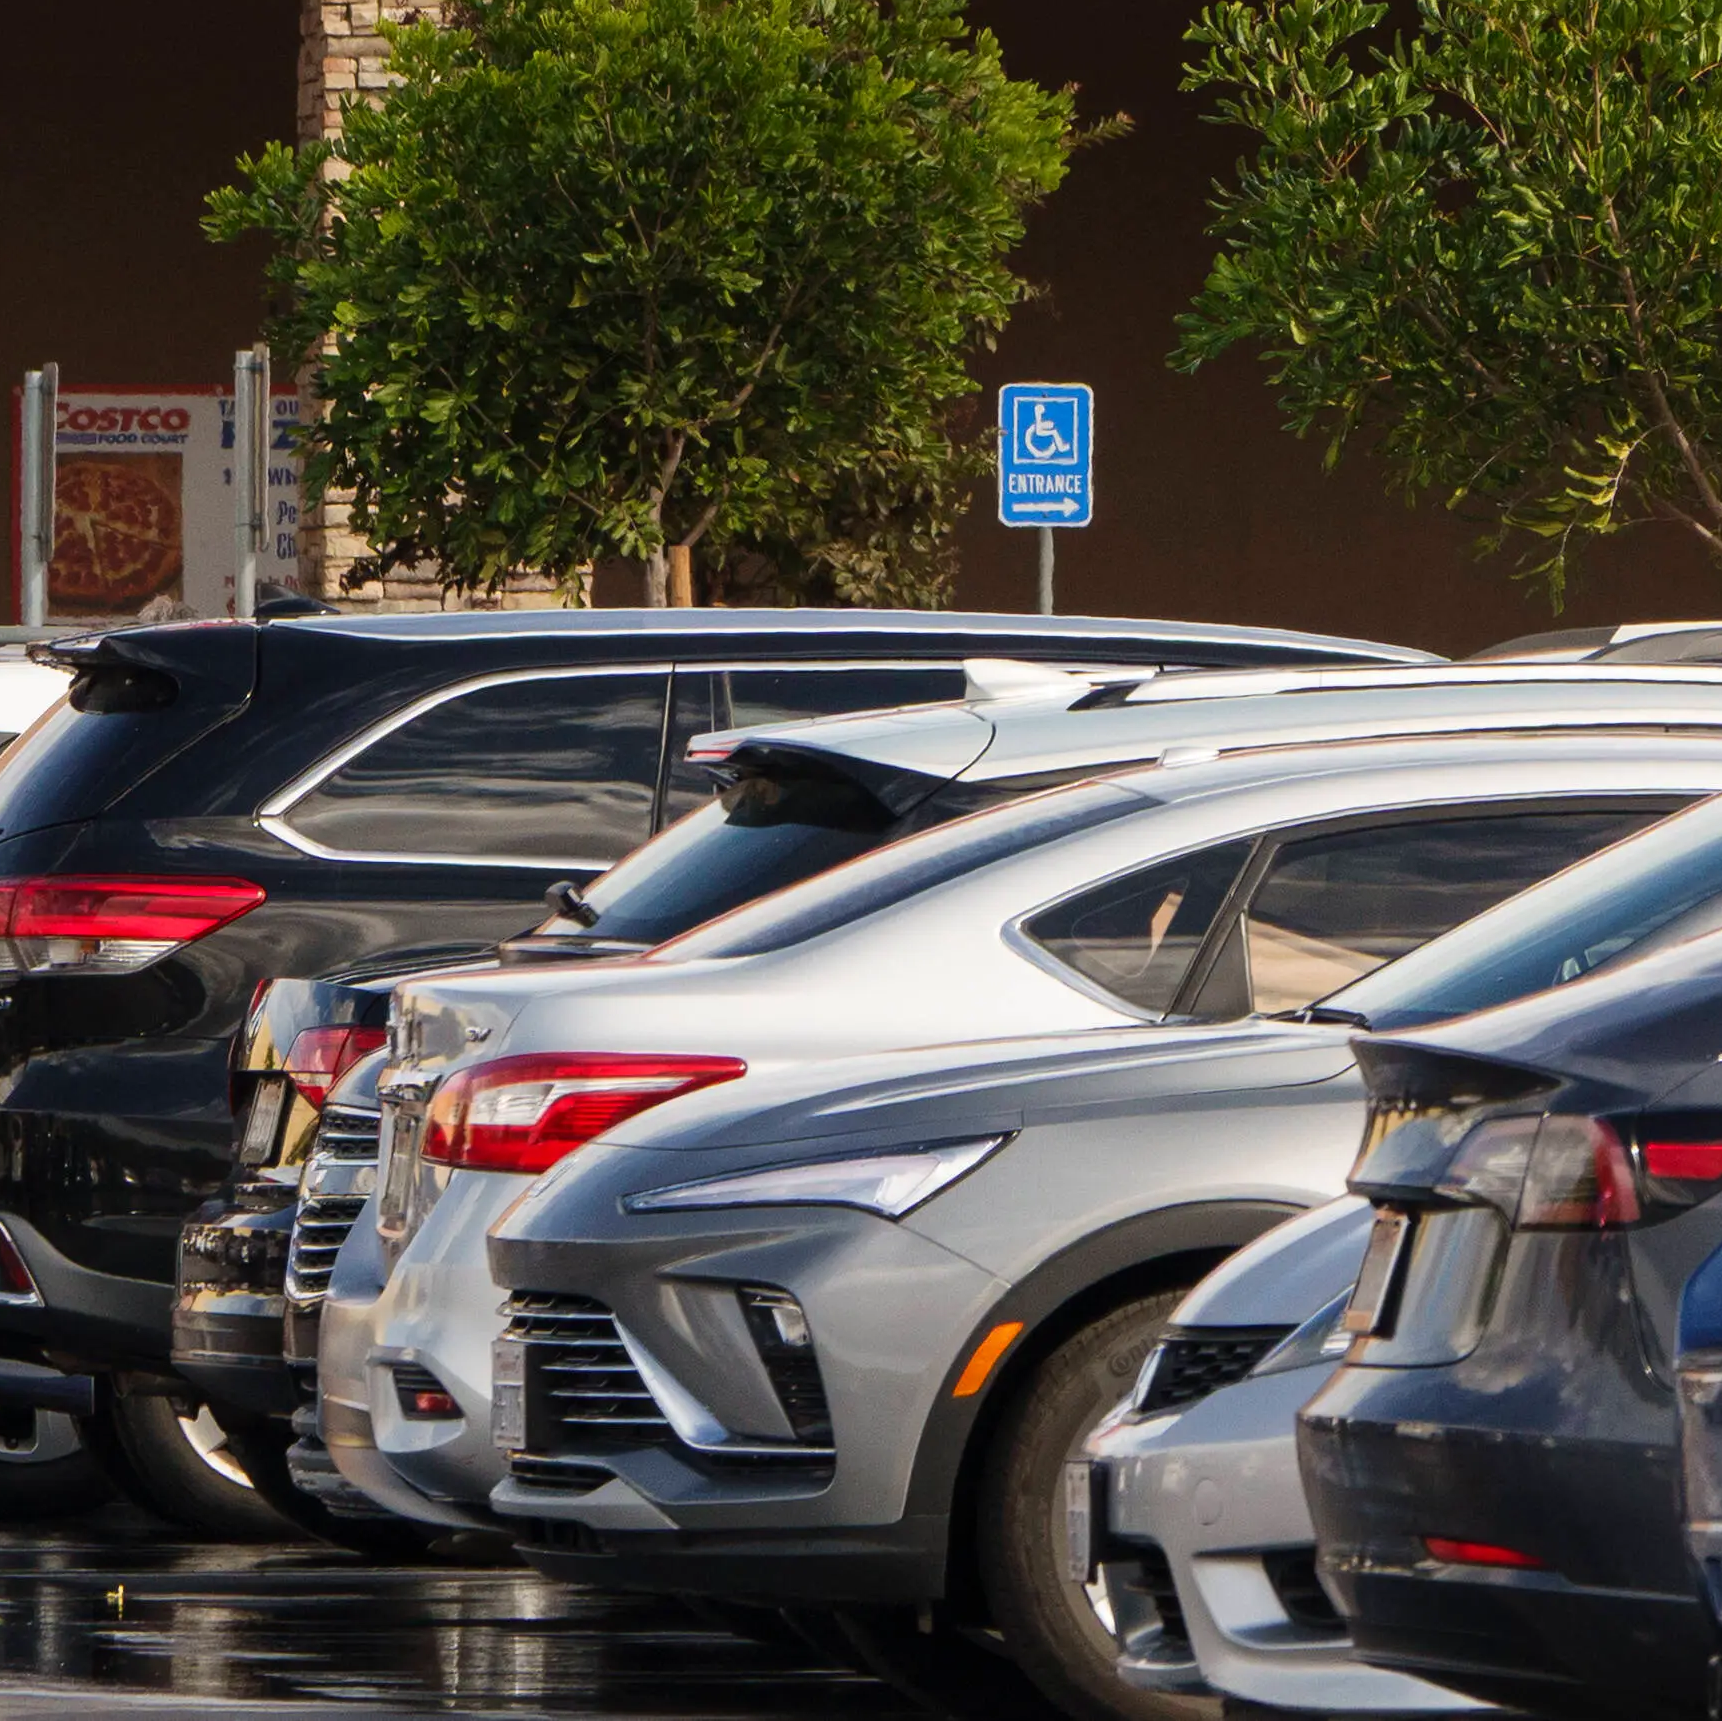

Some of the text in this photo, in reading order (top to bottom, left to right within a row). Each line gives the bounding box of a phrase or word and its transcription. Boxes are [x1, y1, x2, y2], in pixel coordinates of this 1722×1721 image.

[99, 433, 188, 444] FOOD COURT
[1008, 473, 1082, 495] ENTRANCE
